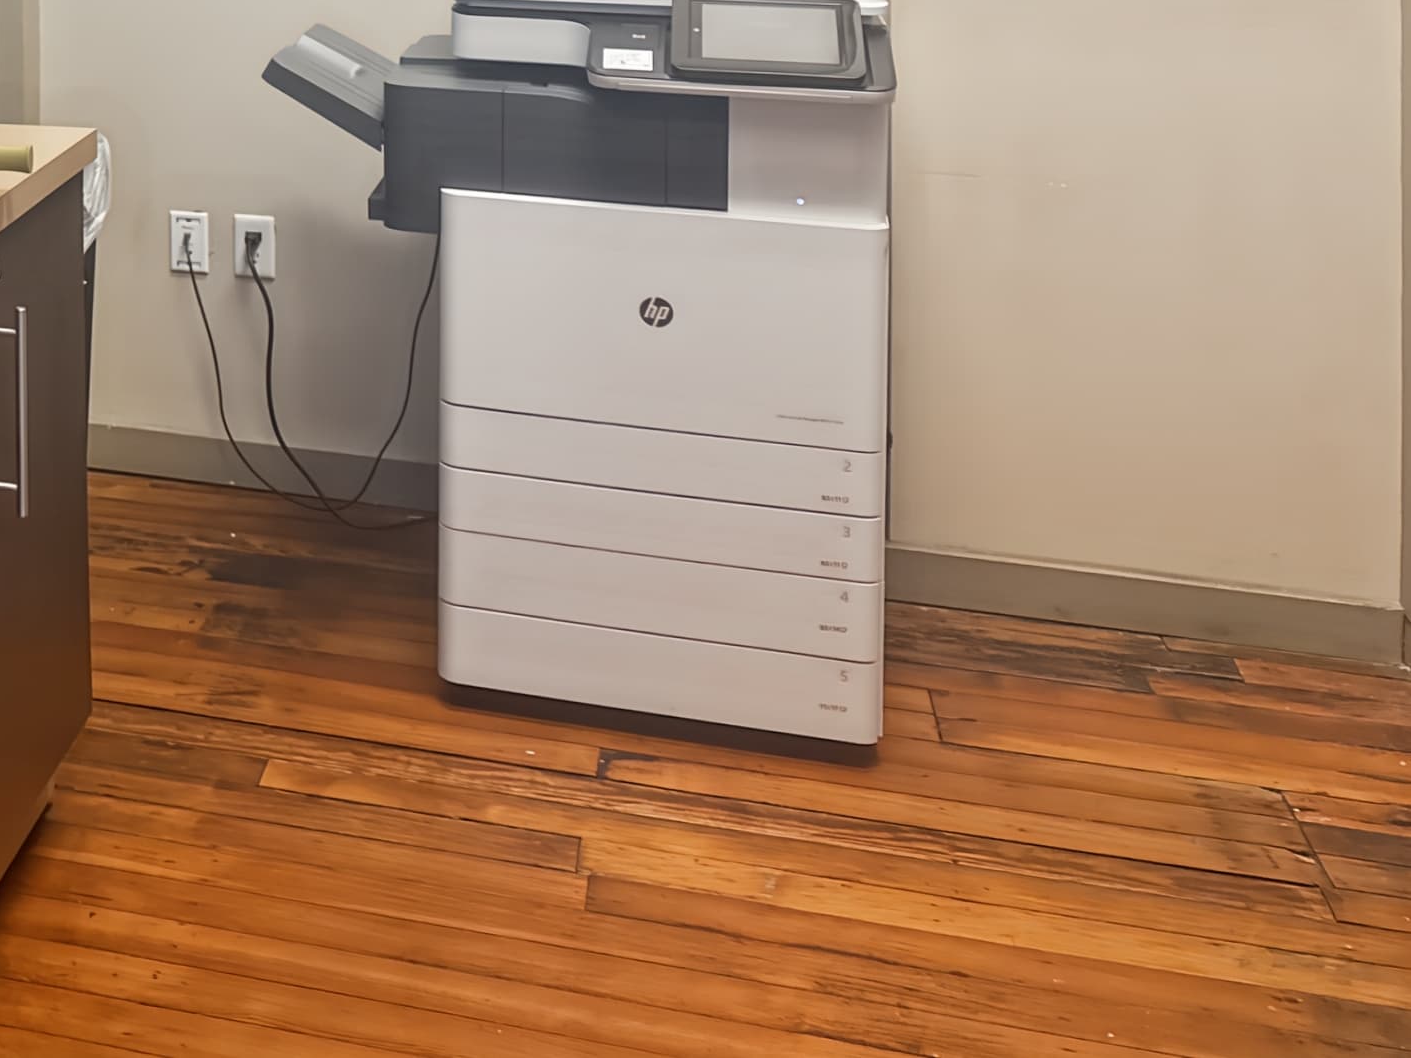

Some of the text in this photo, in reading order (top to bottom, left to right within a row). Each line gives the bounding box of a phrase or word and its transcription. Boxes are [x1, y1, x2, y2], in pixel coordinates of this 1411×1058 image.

[641, 297, 672, 327] hp
[843, 459, 853, 472] 2
[839, 591, 849, 603] 4
[840, 670, 849, 682] 5
